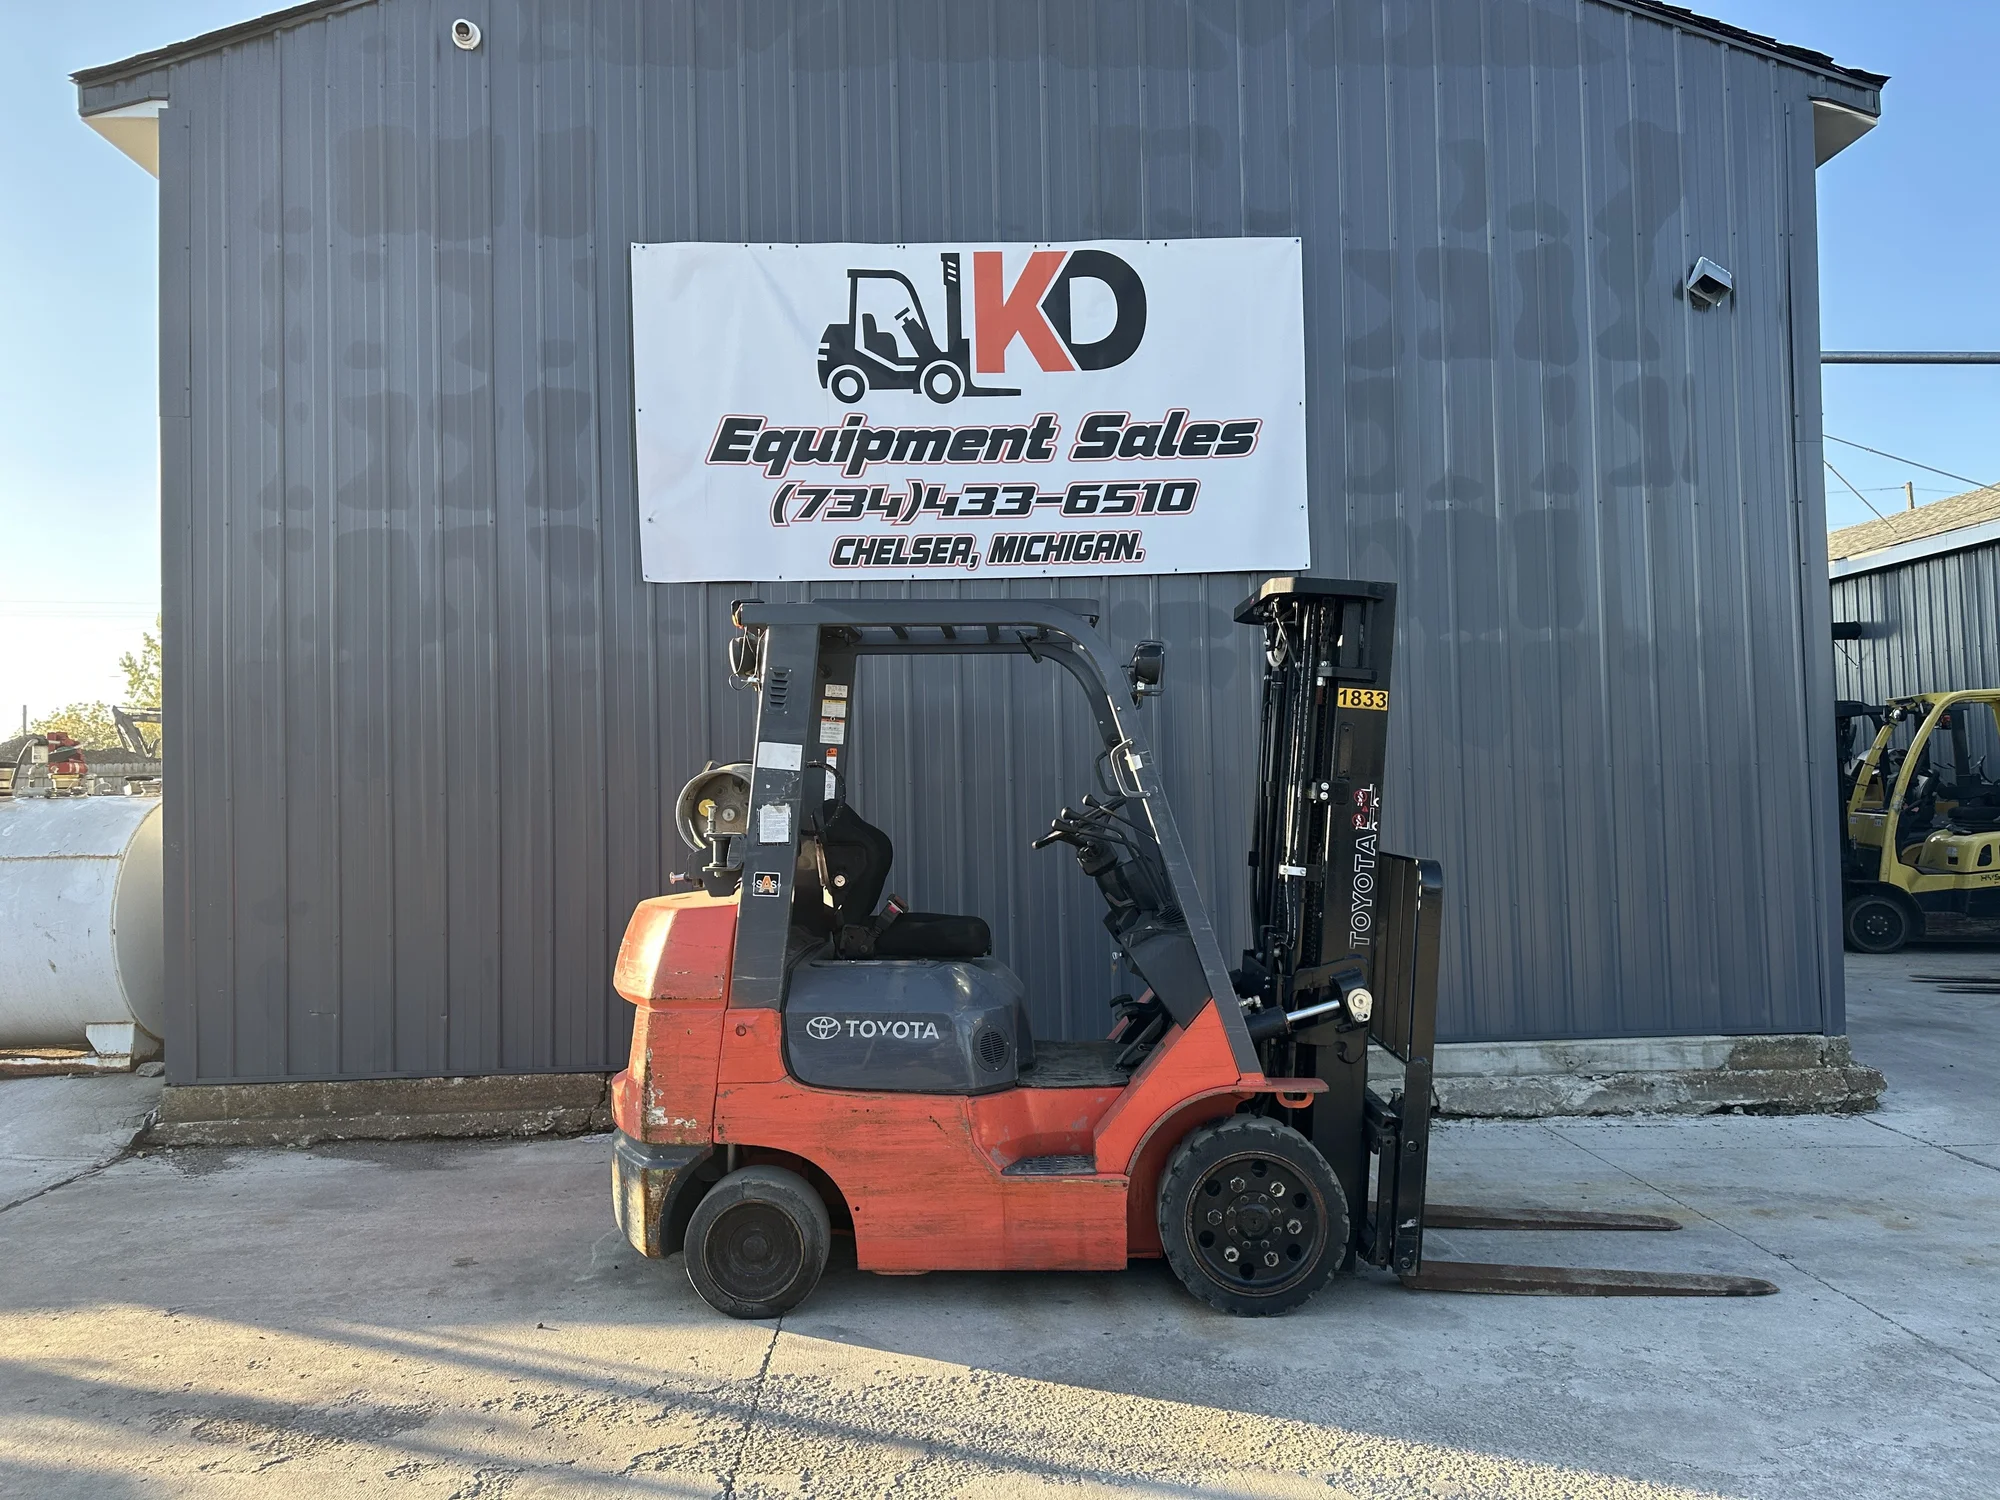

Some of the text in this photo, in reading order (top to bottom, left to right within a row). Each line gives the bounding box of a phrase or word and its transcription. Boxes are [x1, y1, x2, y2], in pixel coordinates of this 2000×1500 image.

[973, 249, 1147, 374] KD
[705, 408, 1263, 479] Equipment Sales
[770, 478, 1201, 527] (734)433-6510
[829, 531, 1146, 571] CHELSEA, MICHIGAN.
[1339, 689, 1387, 708] 1833
[1350, 833, 1377, 949] TOYOTA
[845, 1019, 940, 1040] TOYOTA
